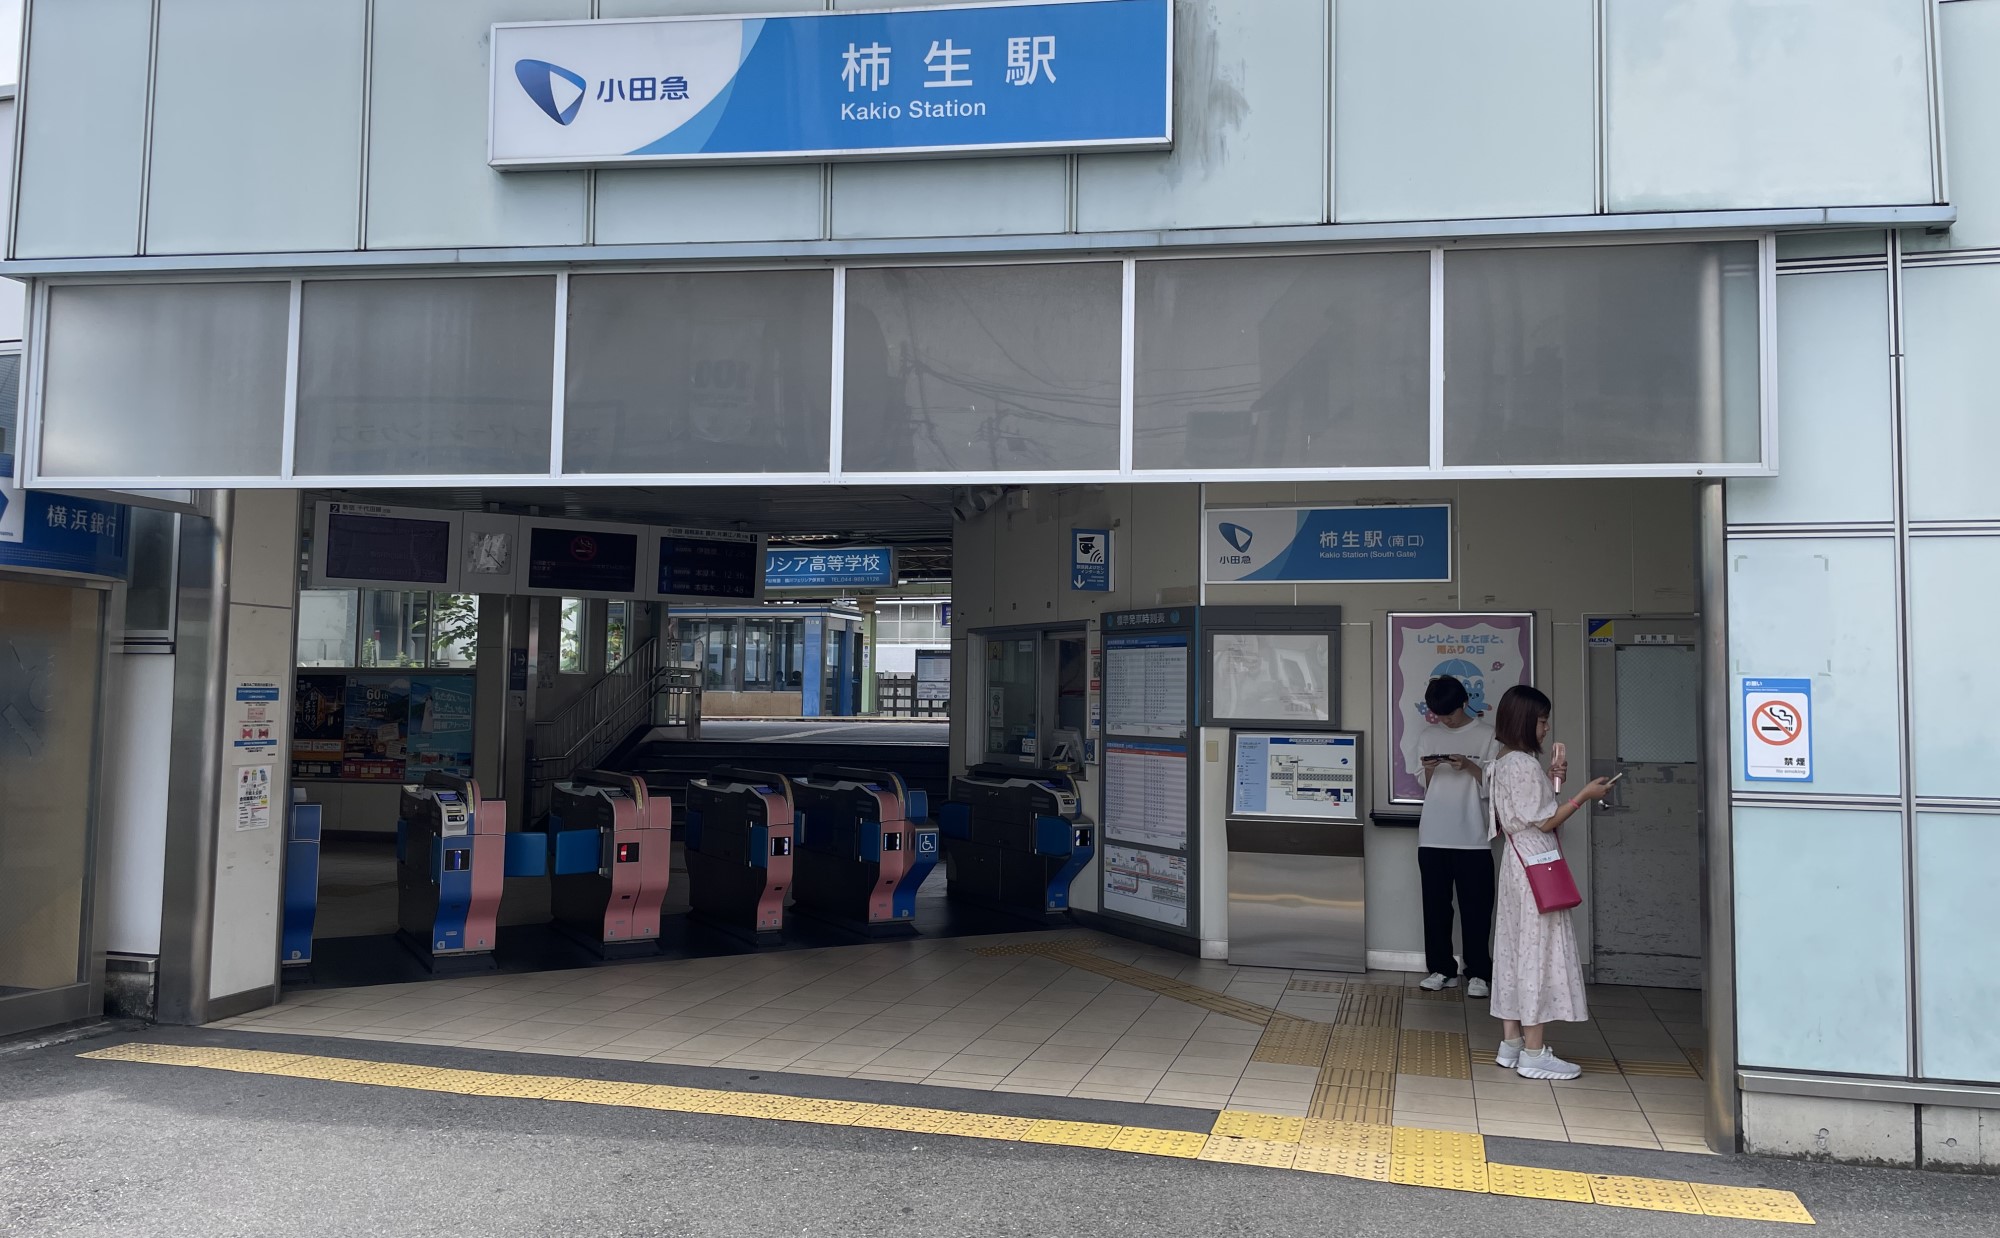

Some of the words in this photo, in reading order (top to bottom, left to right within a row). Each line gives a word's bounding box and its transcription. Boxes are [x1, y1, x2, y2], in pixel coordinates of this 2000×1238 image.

[841, 35, 1057, 93] 柿生駅
[597, 75, 690, 104] 小田急
[840, 102, 902, 120] Kakio
[909, 99, 987, 118] Station
[331, 504, 339, 513] 2
[47, 504, 117, 538] 横浜銀行
[1219, 555, 1252, 565] 小田急
[1319, 552, 1340, 560] Kakio
[1342, 551, 1369, 560] Station
[1370, 551, 1395, 560] (South
[1396, 550, 1417, 560] Gate)
[1437, 645, 1486, 655] 雨ふりの日
[366, 688, 389, 700] 60th
[1784, 757, 1806, 766] 禁煙
